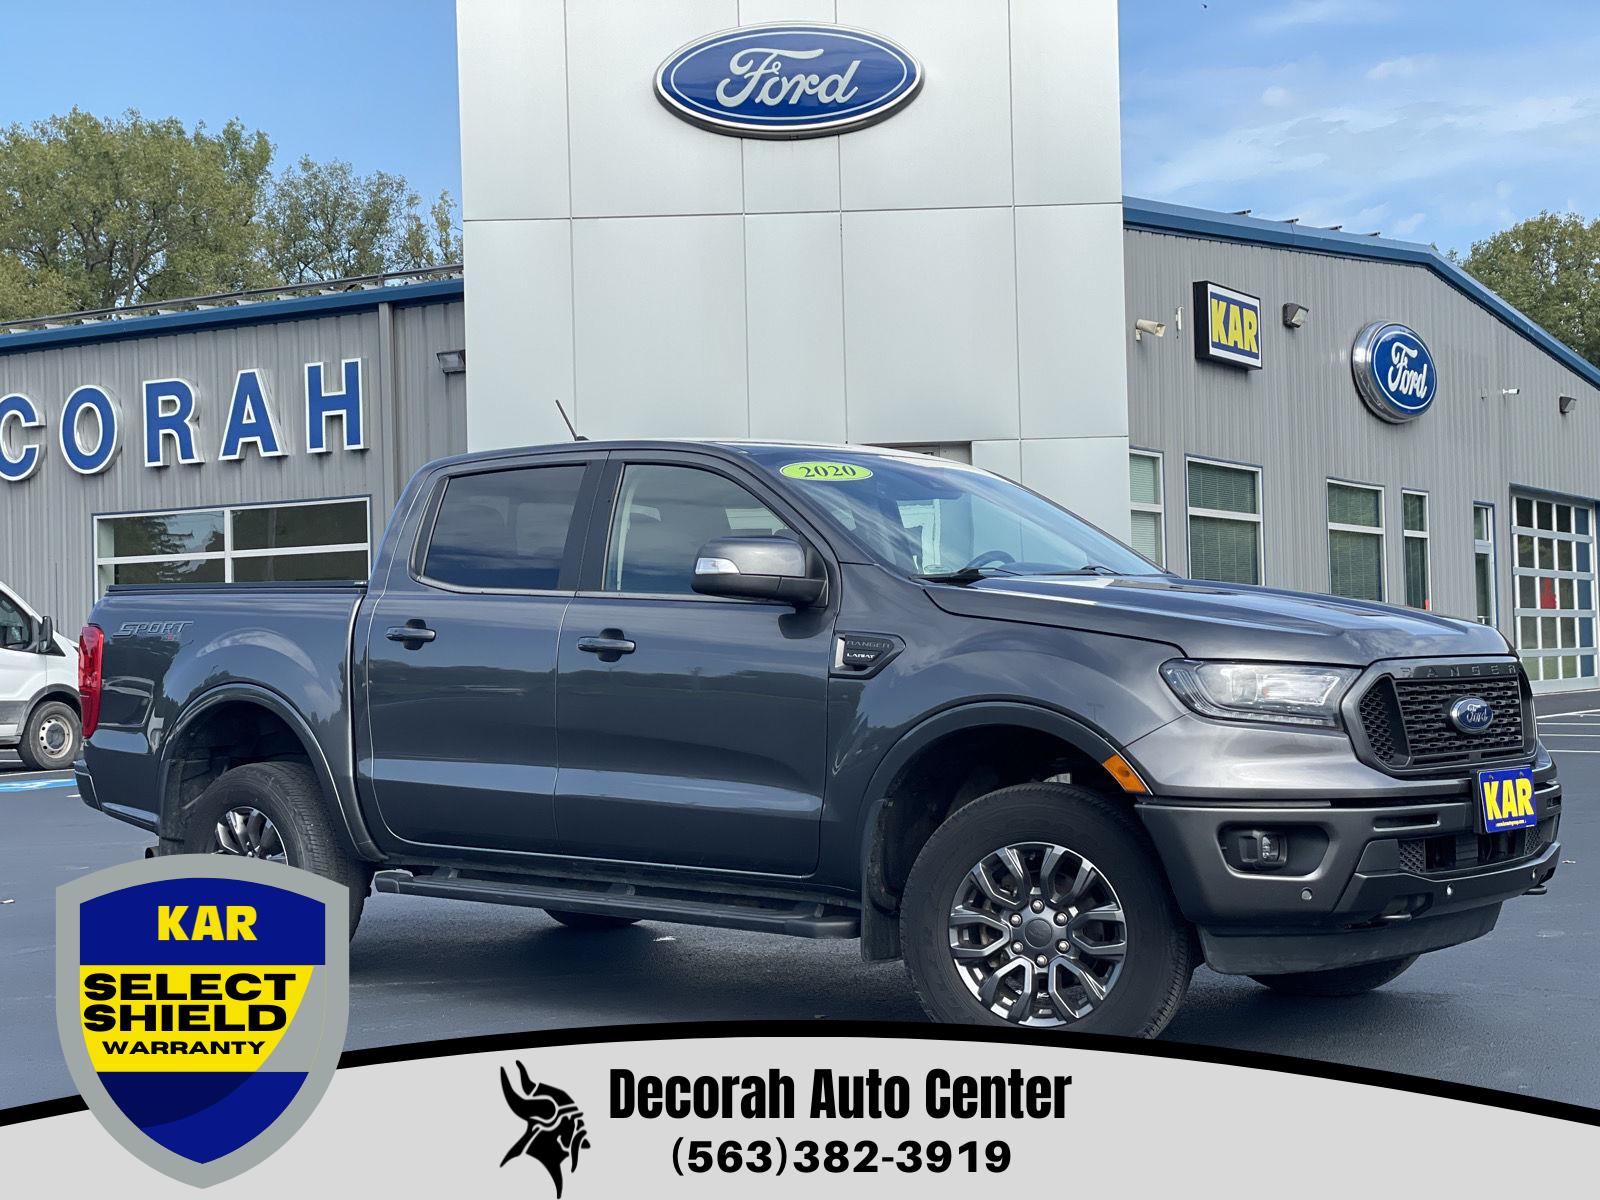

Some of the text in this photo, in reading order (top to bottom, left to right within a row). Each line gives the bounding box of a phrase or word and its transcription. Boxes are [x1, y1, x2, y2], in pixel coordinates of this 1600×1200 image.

[716, 48, 861, 107] Ford
[1211, 298, 1259, 353] KAR
[1388, 342, 1427, 398] Ford
[0, 358, 369, 482] CORAH
[799, 465, 856, 477] 2020
[111, 621, 194, 638] SPORT
[1400, 665, 1516, 677] RANGER
[1466, 703, 1488, 723] Ford
[1483, 778, 1534, 820] KAR
